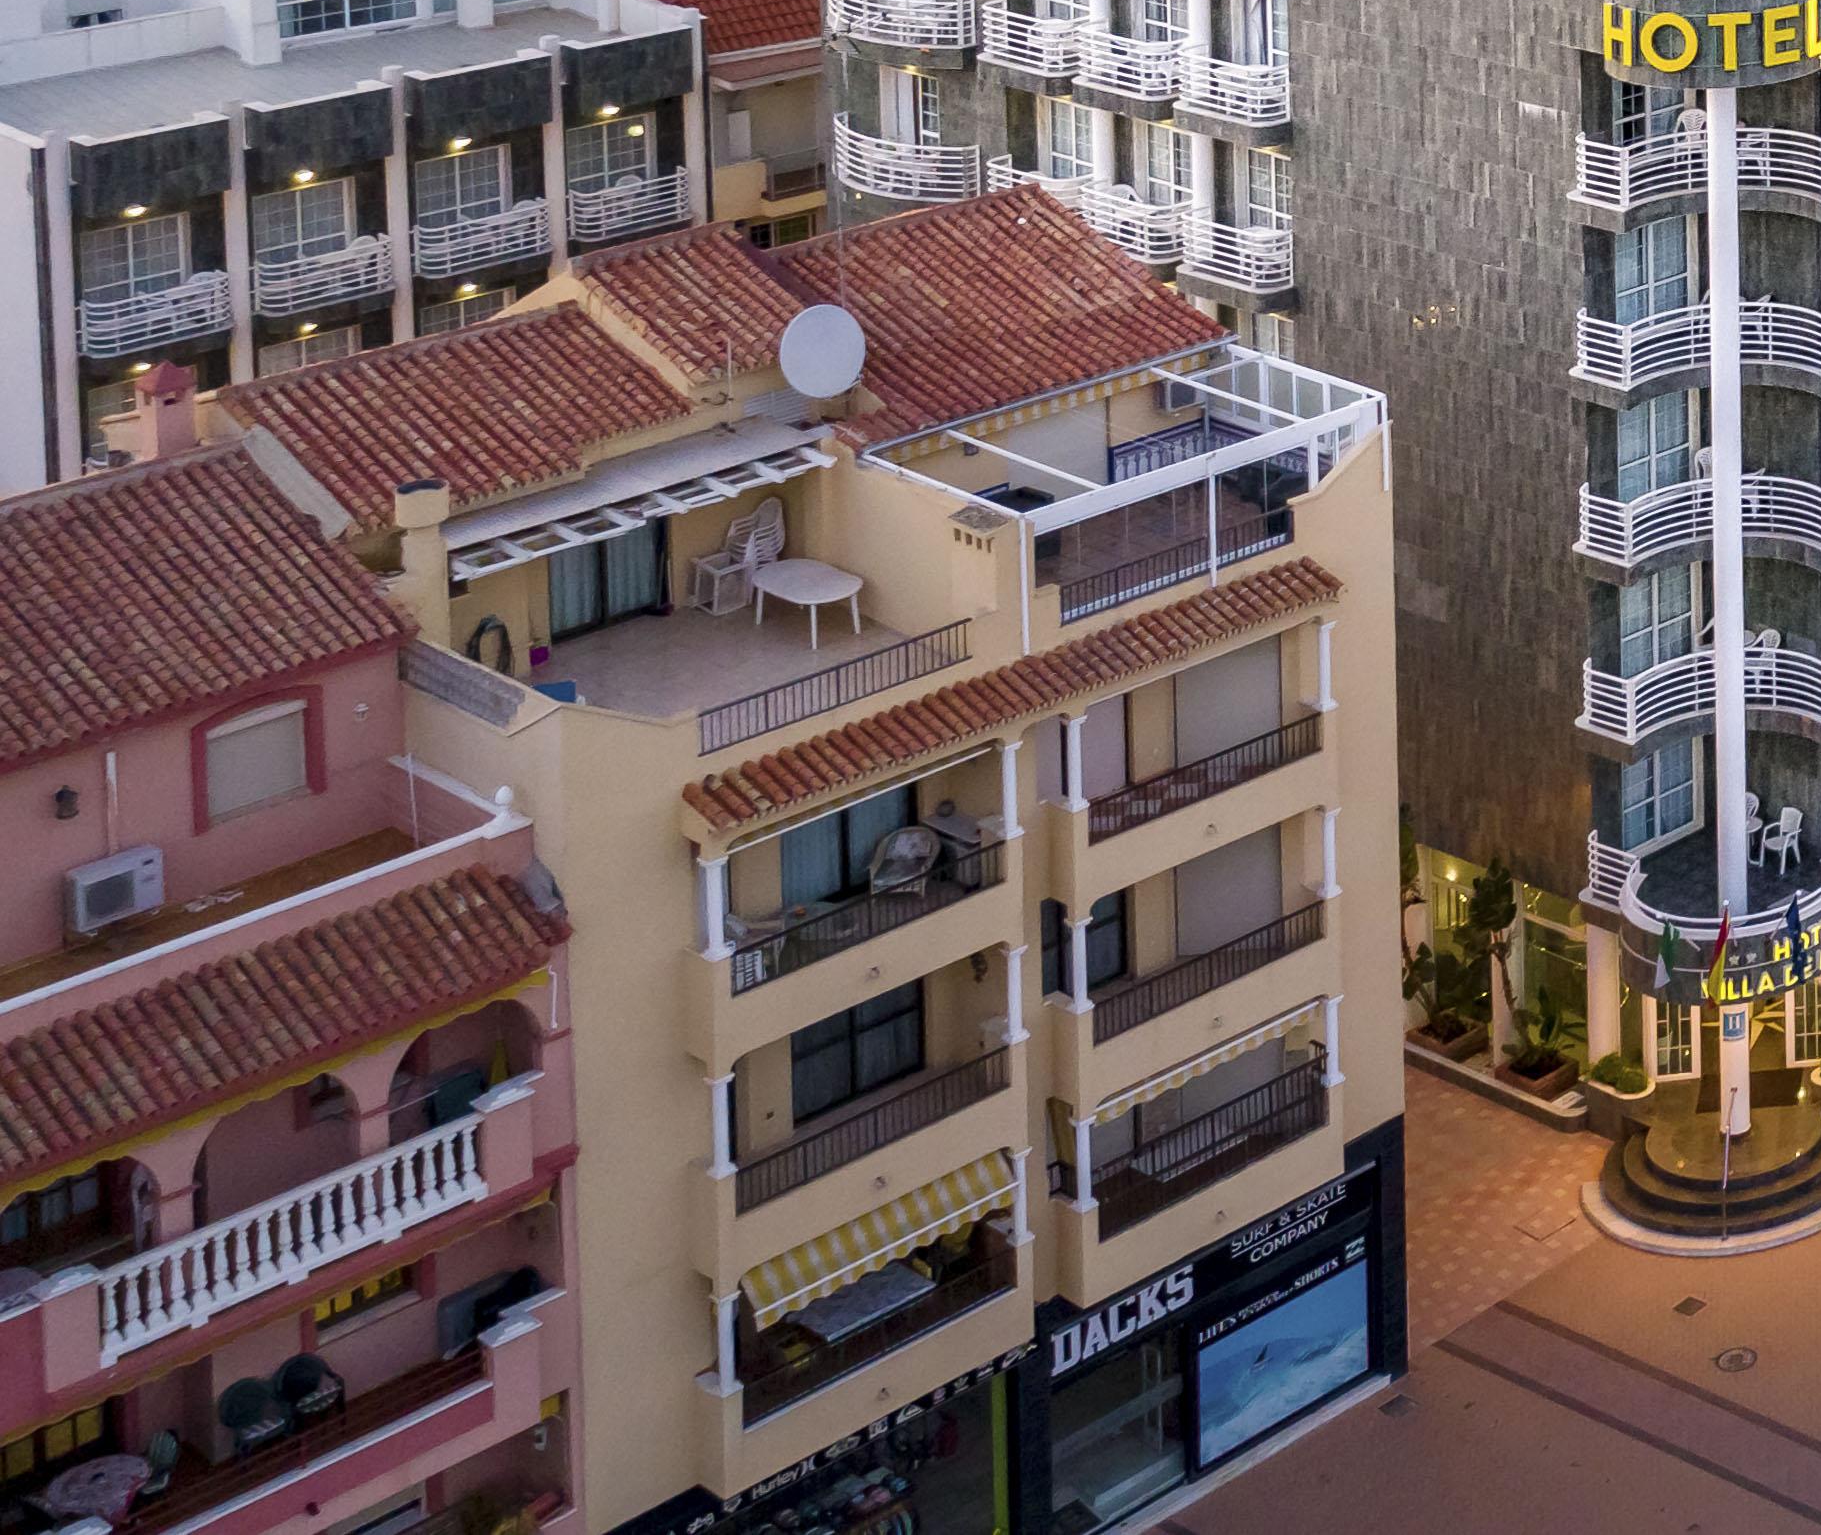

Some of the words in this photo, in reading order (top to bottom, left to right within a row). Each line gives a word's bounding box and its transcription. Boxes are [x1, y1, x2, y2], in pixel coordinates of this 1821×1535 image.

[1231, 1222, 1275, 1253] SURF
[1278, 1211, 1291, 1227] &
[1296, 1183, 1348, 1218] SKATE
[1250, 1210, 1329, 1263] COMPANY
[1051, 1263, 1195, 1377] DACKS
[752, 1466, 799, 1500] Hurley
